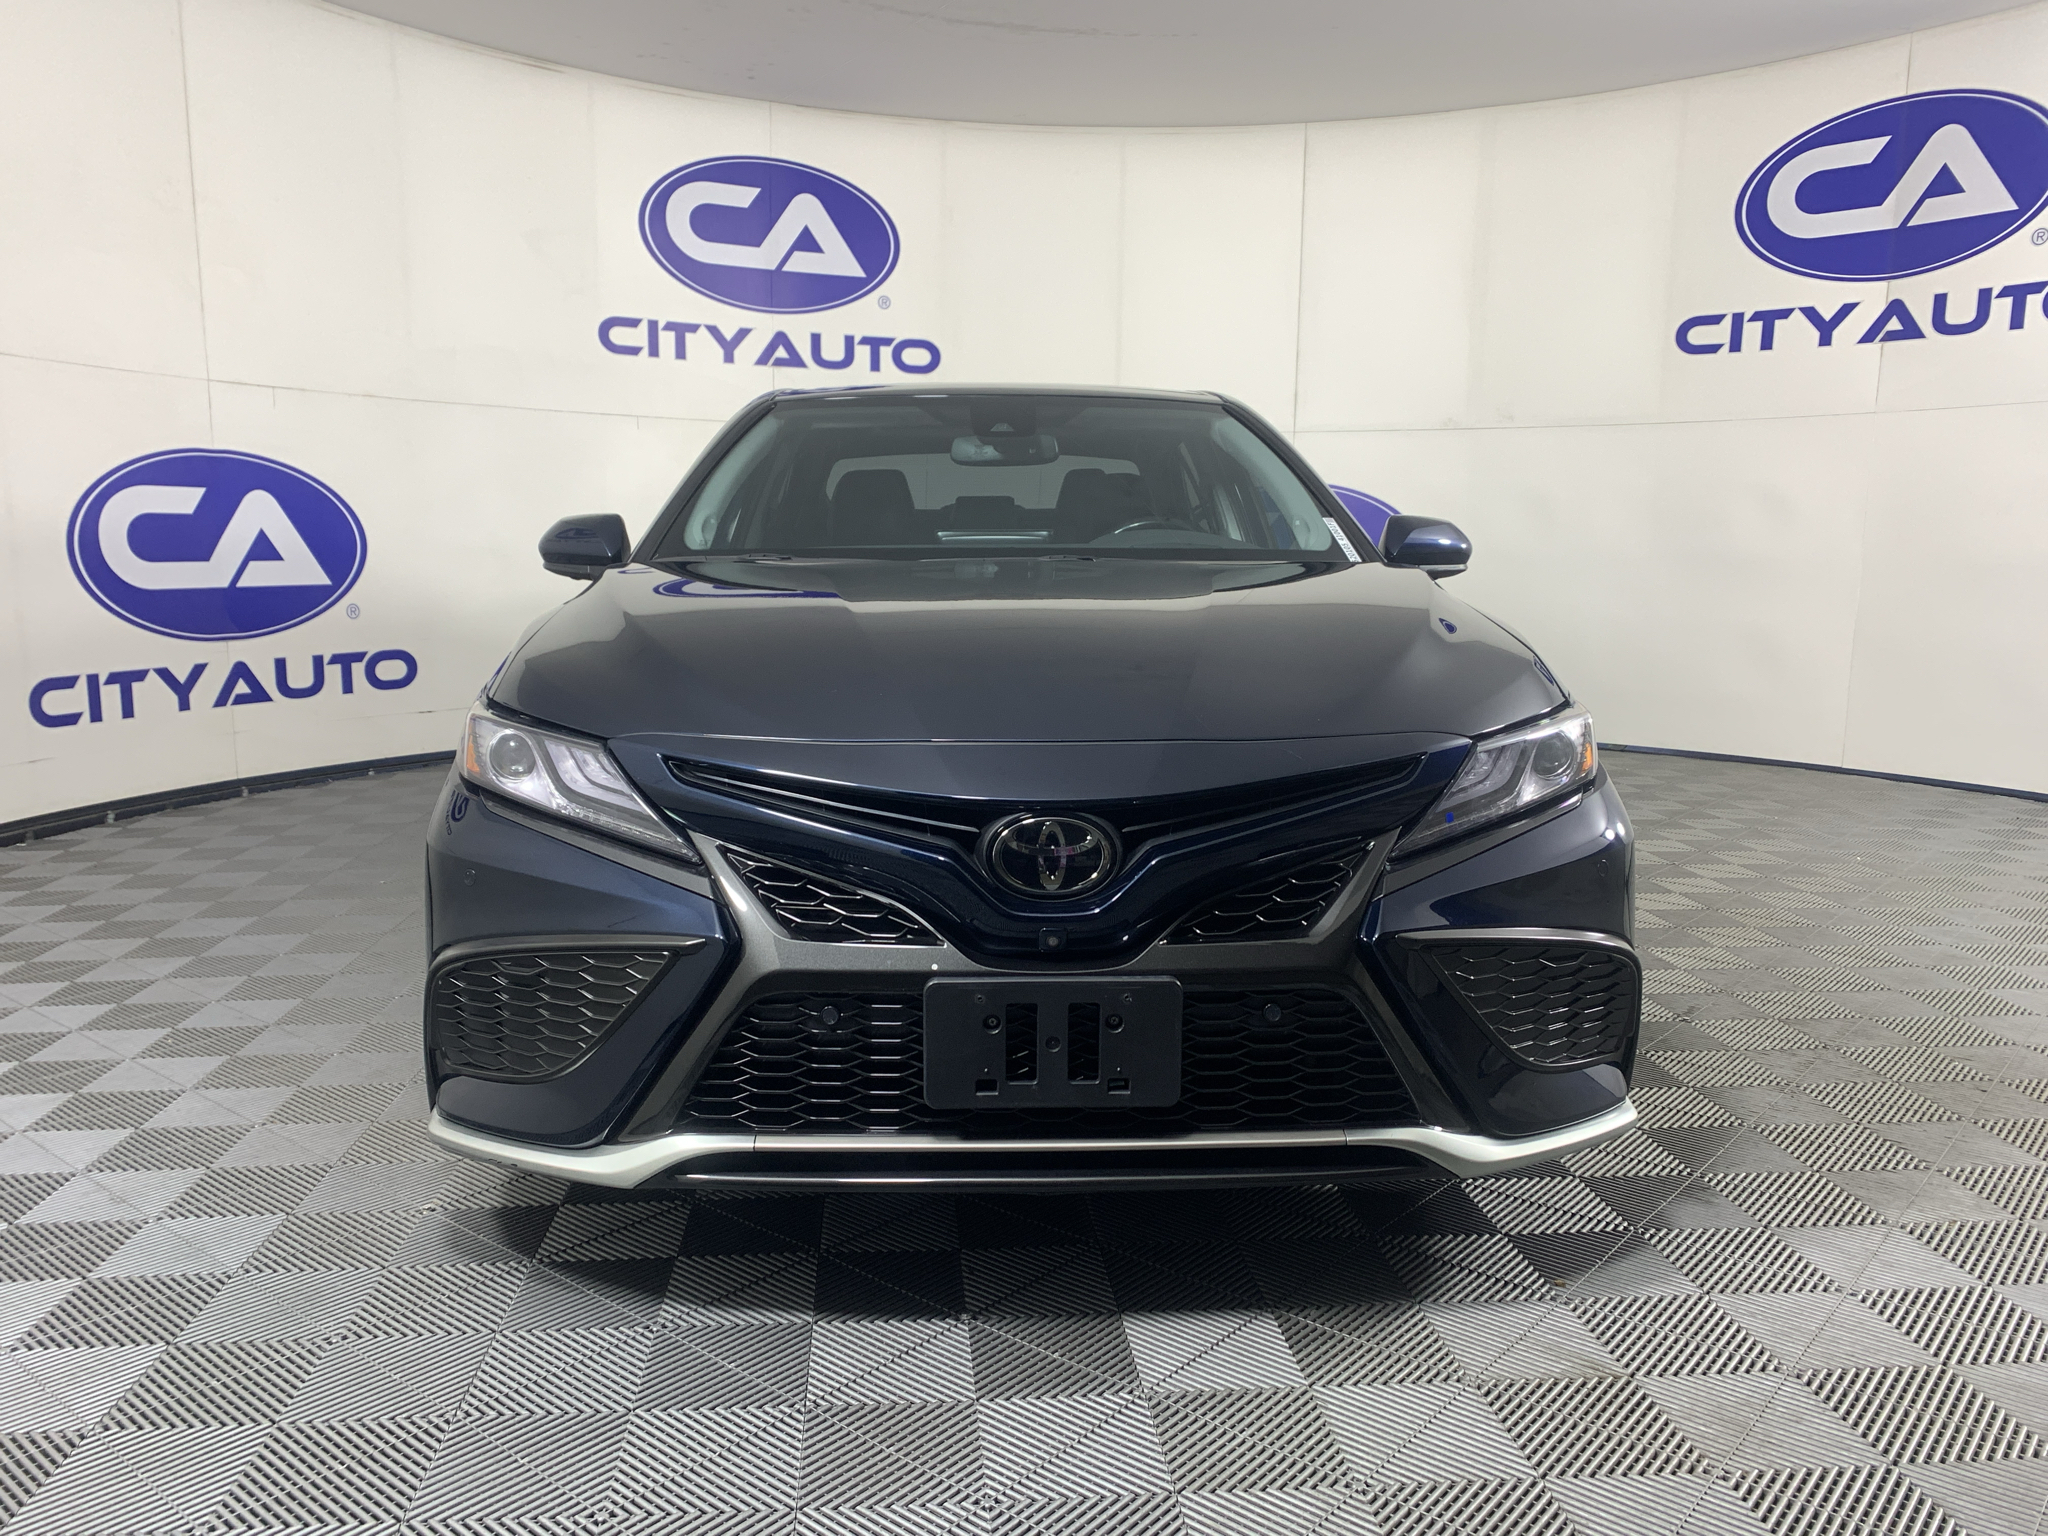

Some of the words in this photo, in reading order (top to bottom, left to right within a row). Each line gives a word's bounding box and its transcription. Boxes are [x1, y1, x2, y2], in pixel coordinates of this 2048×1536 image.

[665, 181, 867, 277] CA
[1767, 124, 2018, 239] CA
[1857, 280, 2048, 344] AUT
[98, 484, 332, 590] CA
